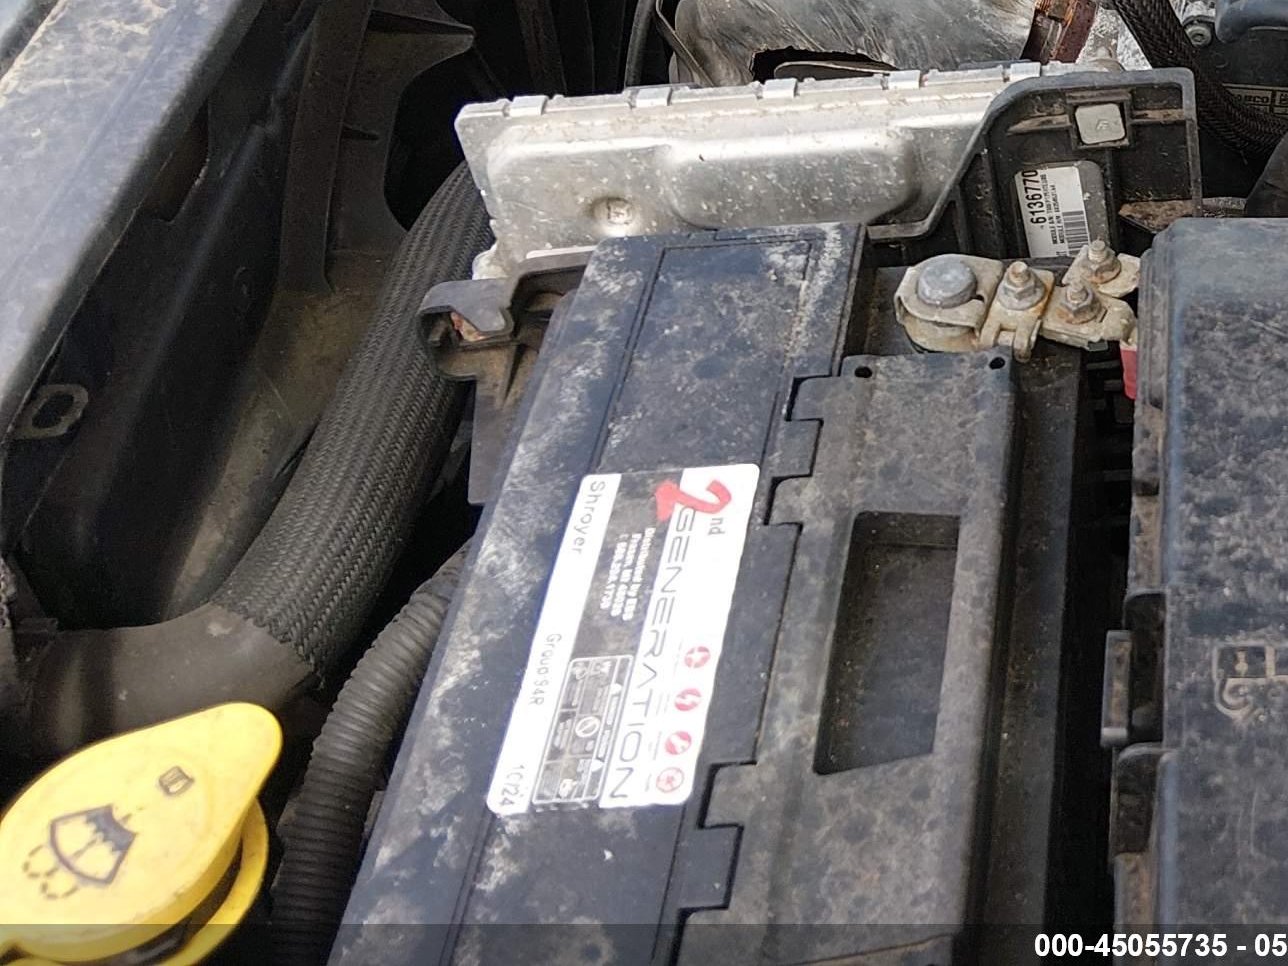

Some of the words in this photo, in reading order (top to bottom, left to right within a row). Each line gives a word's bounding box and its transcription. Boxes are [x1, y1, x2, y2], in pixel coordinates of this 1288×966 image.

[1022, 170, 1046, 224] 6136770
[570, 481, 606, 555] Shroyer
[632, 527, 656, 583] Distributed
[627, 583, 641, 598] by
[608, 505, 696, 799] GENERATION
